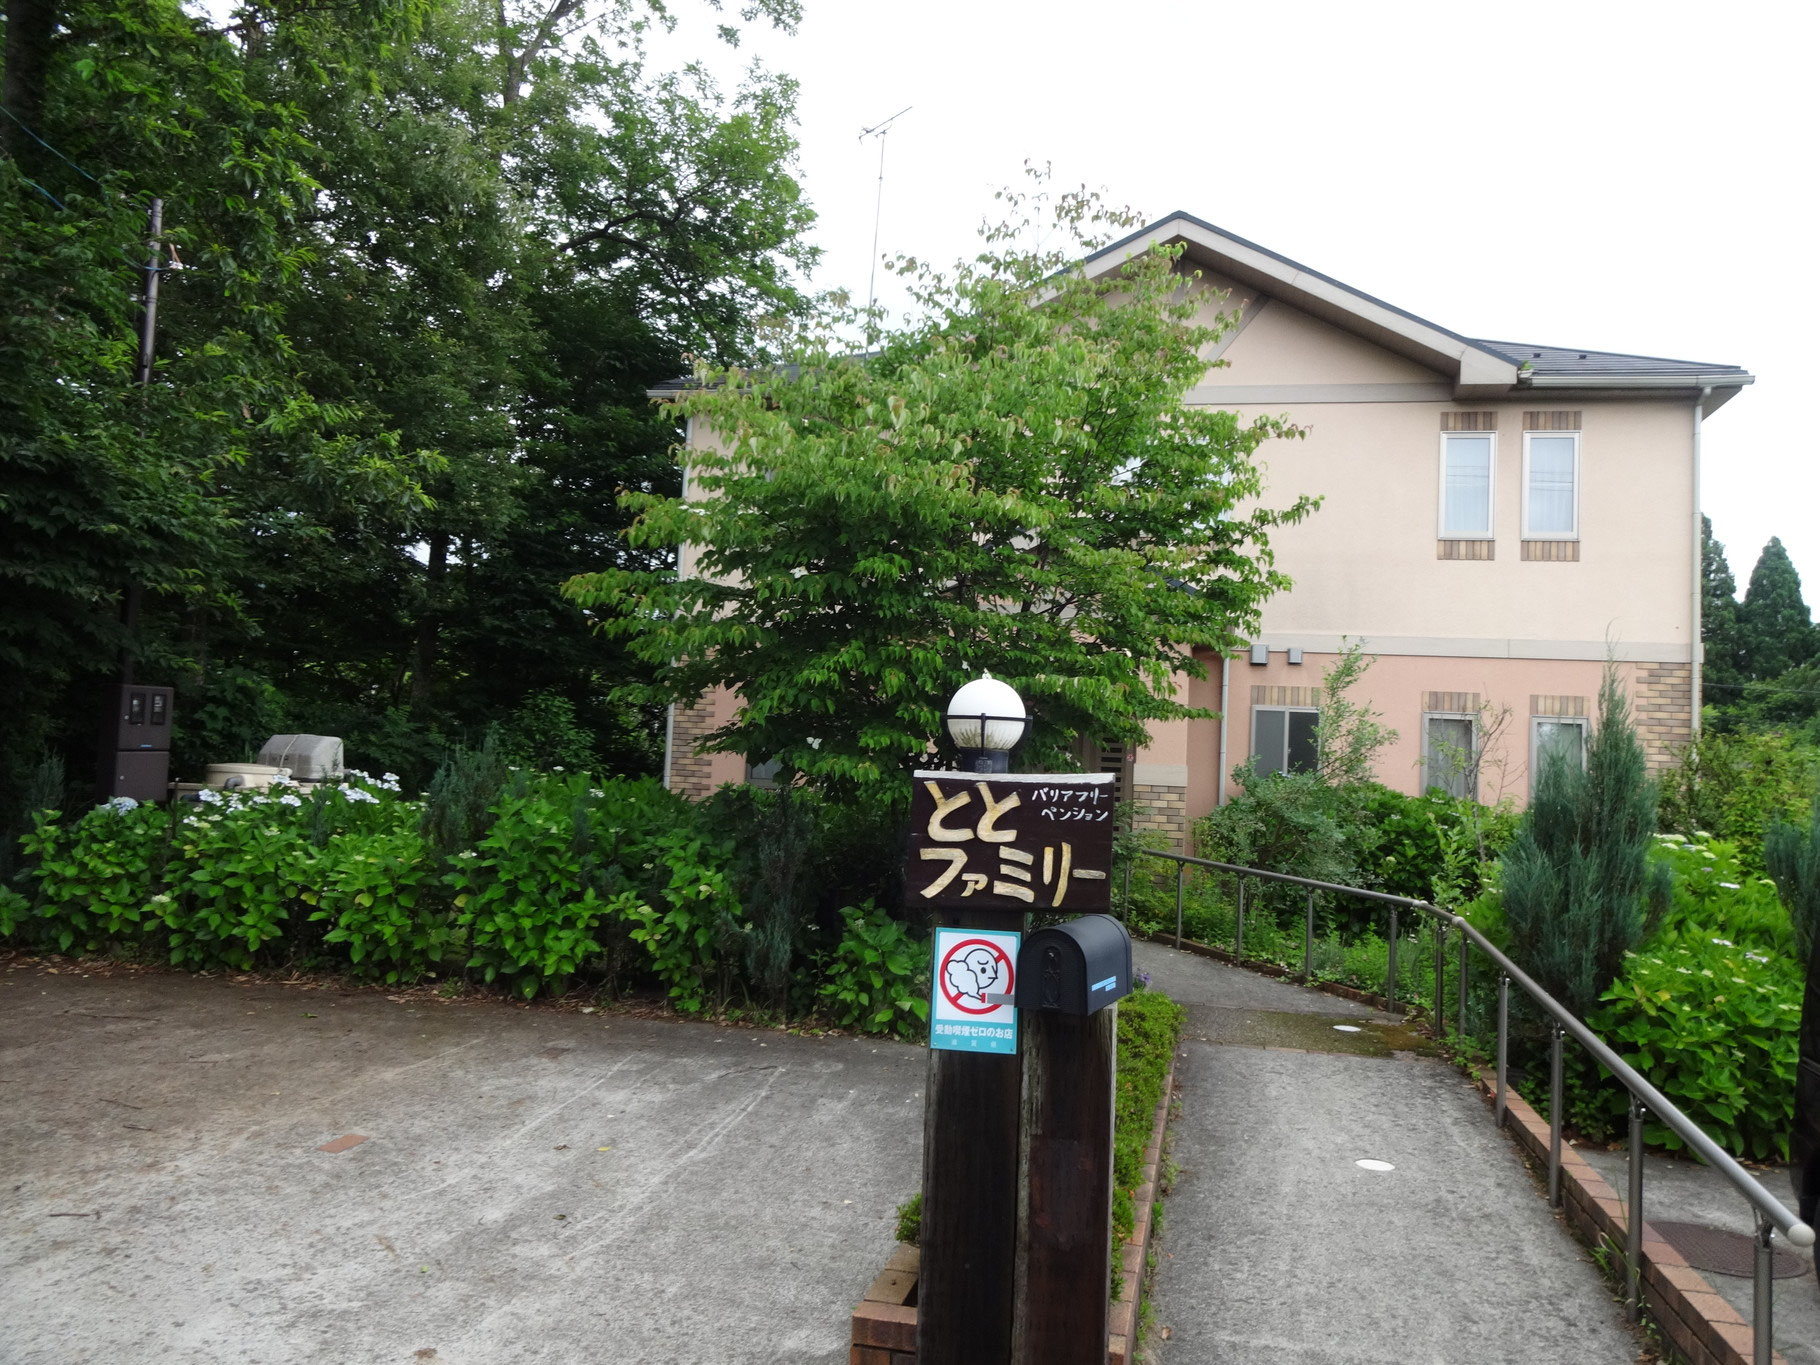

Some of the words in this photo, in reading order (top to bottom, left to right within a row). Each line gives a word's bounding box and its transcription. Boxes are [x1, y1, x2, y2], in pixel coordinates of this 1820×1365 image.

[924, 780, 1021, 843] とと
[1031, 787, 1109, 805] バリアフリー
[1041, 806, 1109, 821] ペンション
[919, 842, 1106, 907] ファミリー
